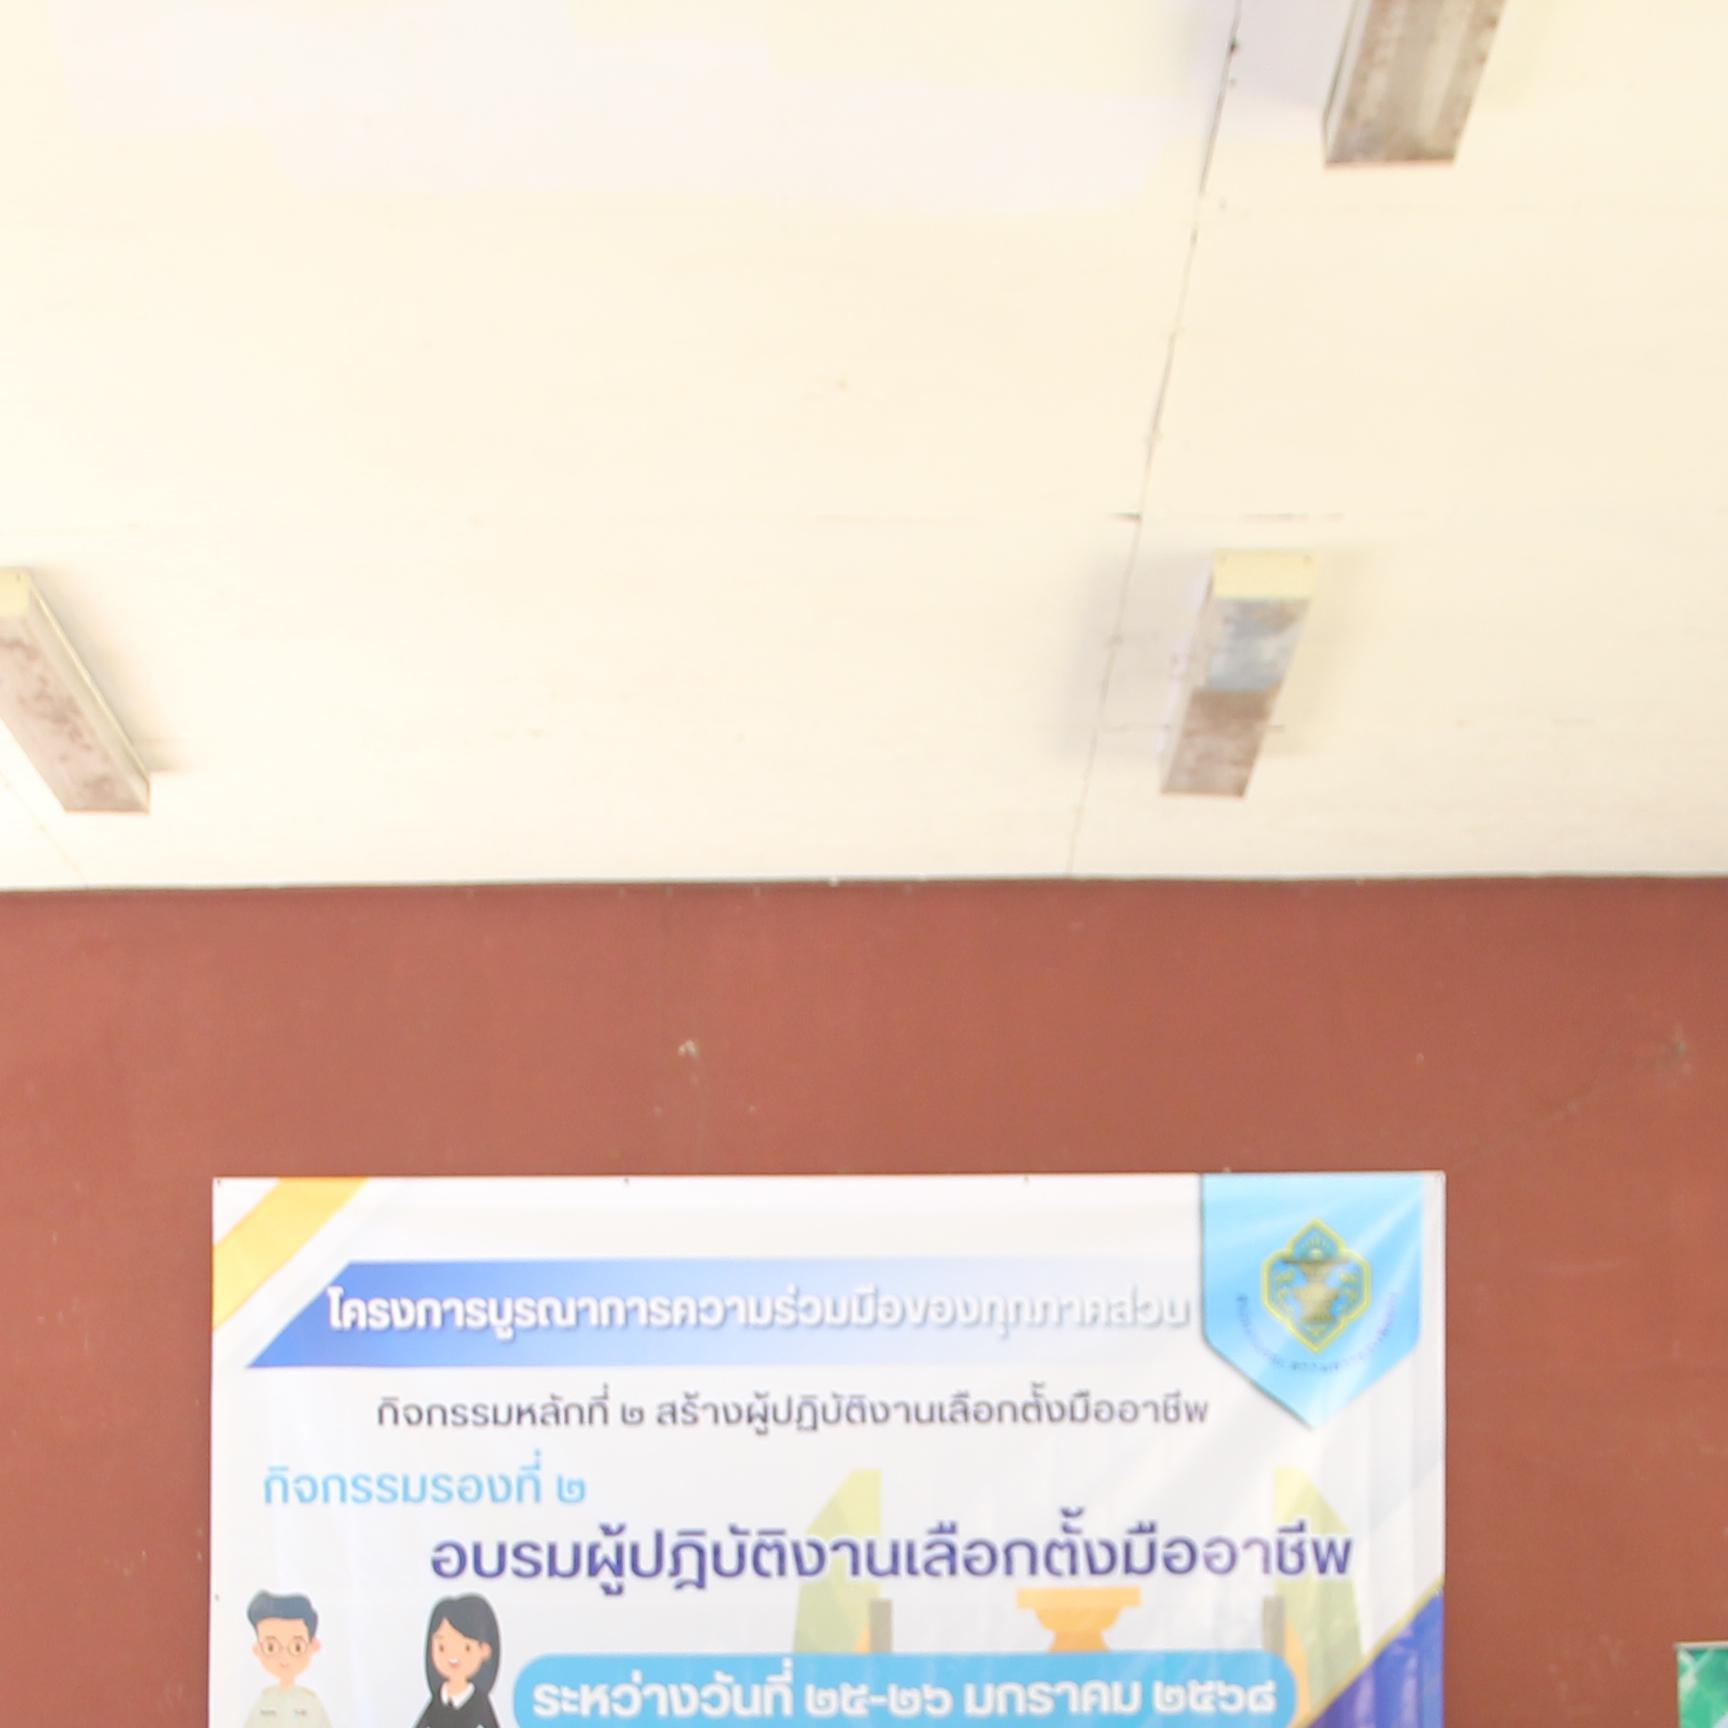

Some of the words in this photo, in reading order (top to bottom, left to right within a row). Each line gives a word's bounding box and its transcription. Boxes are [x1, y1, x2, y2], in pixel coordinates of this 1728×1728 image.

[326, 1284, 1191, 1341] โครงการบูรณาการความร่วมมือของทุกภาคส่วน
[376, 1384, 610, 1428] กิจกรรมหลักที่
[620, 1405, 645, 1427] ๒
[262, 1450, 542, 1505] กิจกรรมรองที่
[556, 1471, 588, 1505] ๒
[532, 1658, 794, 1719] ระหว่างวันที่
[963, 1676, 1143, 1717] มกราคม
